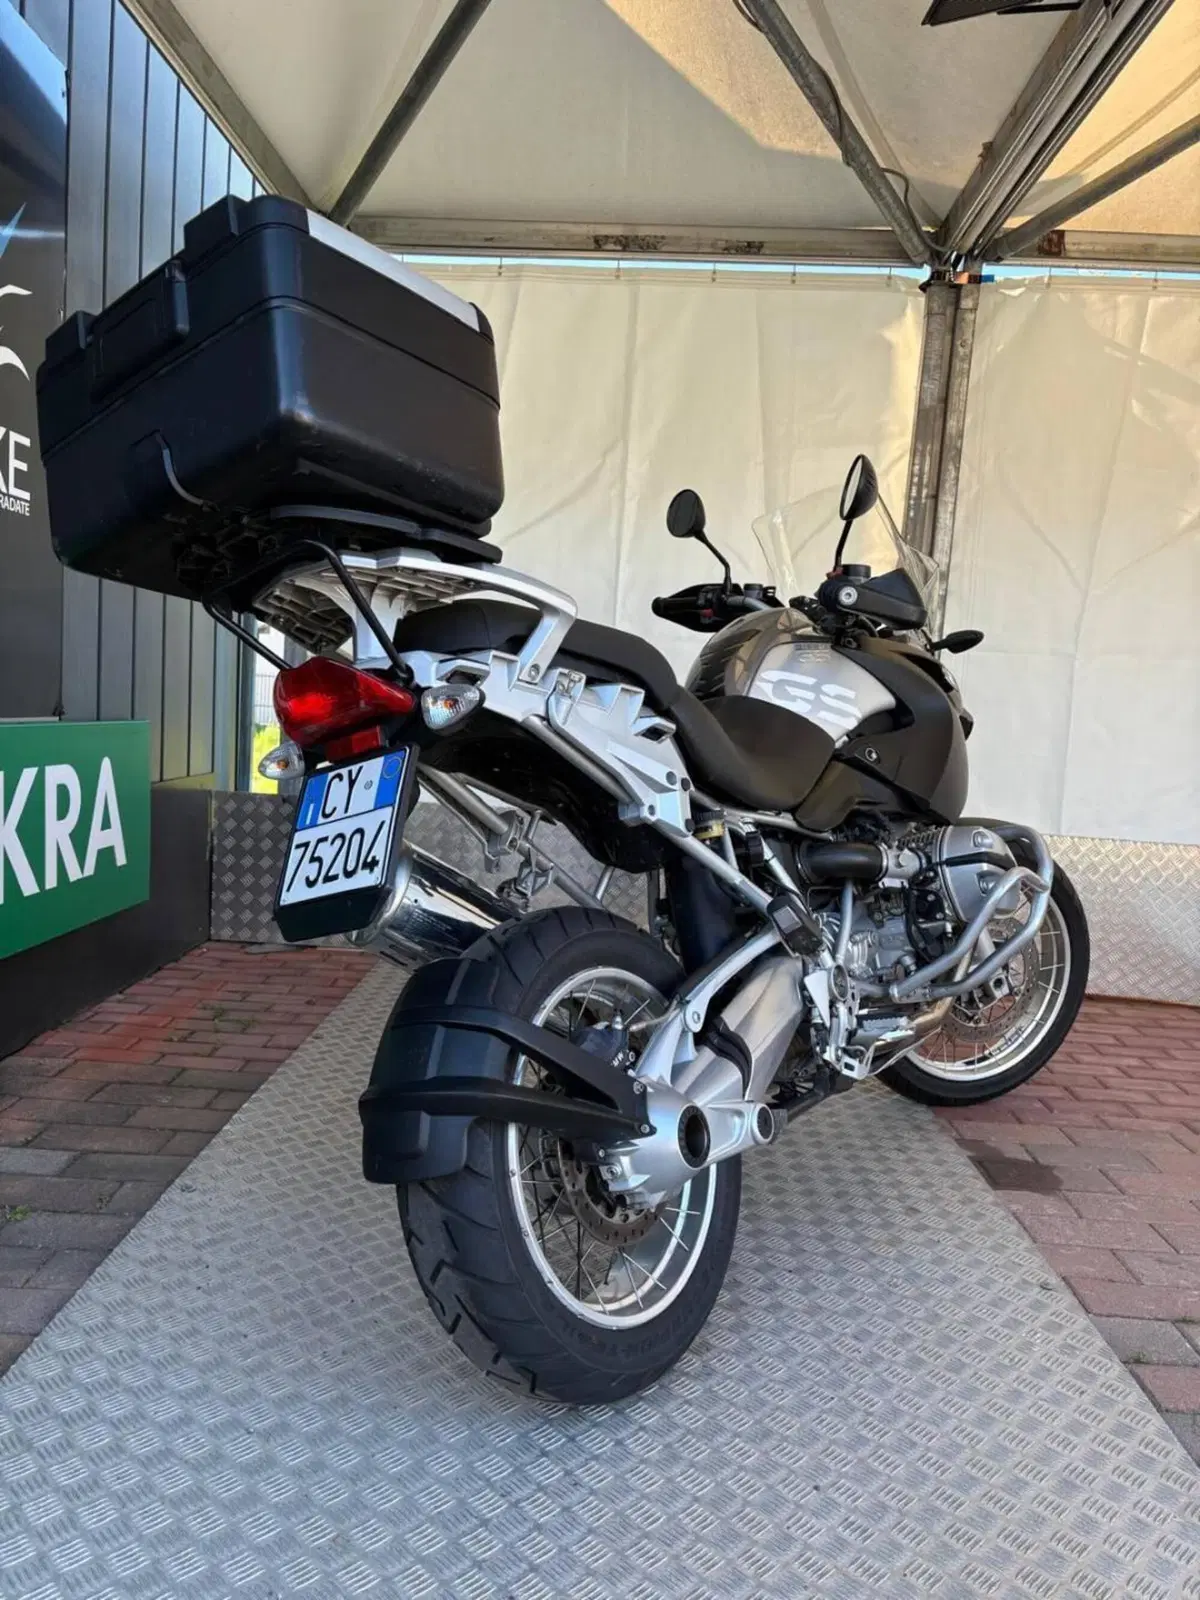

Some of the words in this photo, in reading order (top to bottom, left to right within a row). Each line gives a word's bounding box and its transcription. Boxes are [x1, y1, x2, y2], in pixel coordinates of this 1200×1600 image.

[757, 670, 862, 730] GS
[321, 765, 364, 820] CY
[0, 756, 127, 905] KRA
[286, 820, 386, 893] 75204
